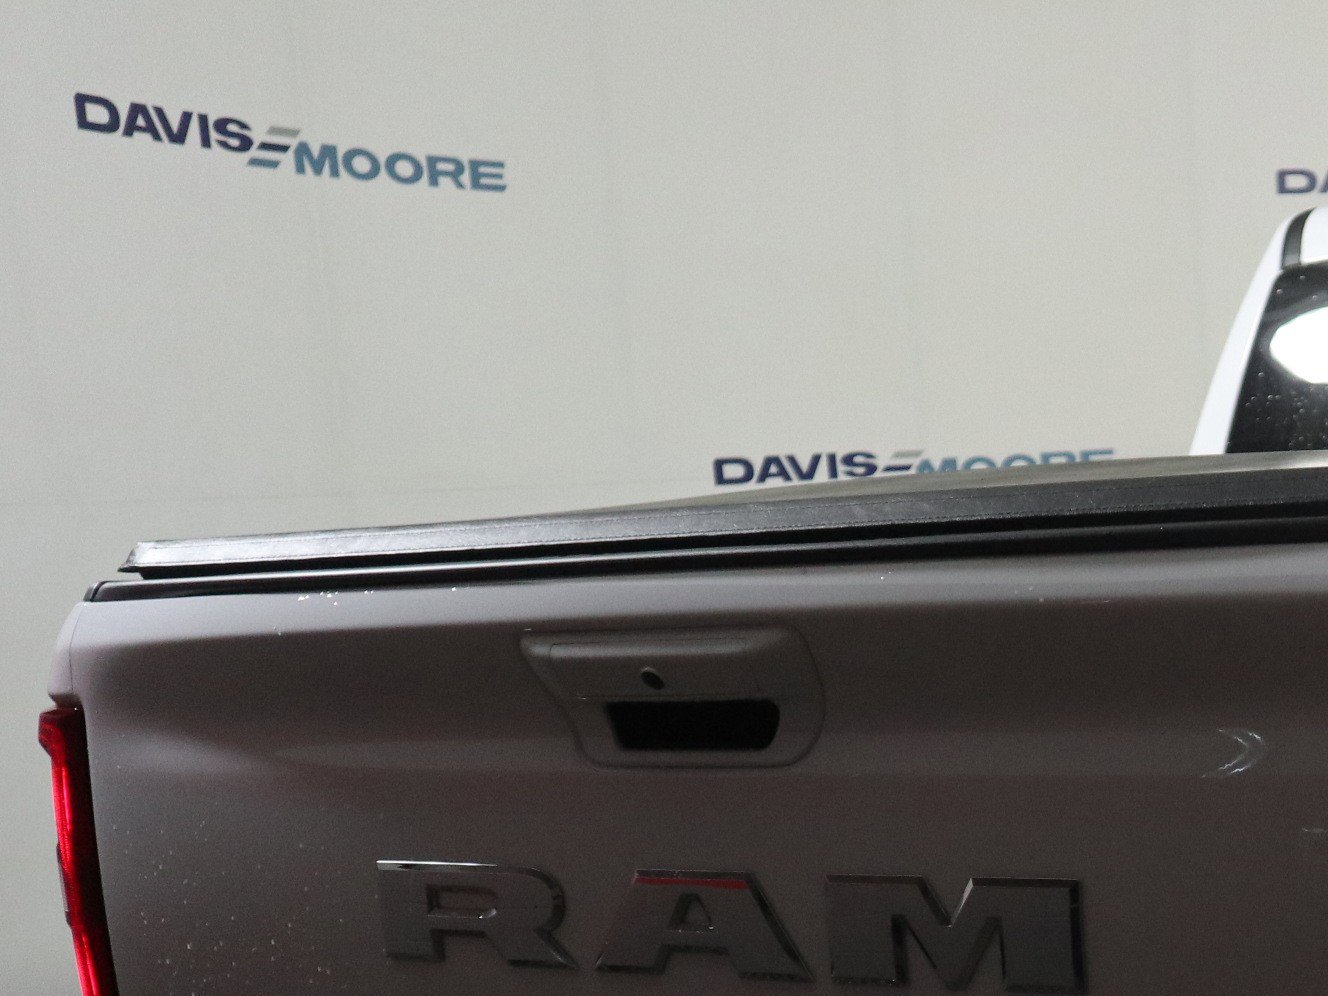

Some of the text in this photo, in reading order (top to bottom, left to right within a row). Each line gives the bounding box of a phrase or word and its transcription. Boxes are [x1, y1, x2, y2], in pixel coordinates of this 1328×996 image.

[73, 92, 508, 192] DAVIS MOORE
[712, 450, 879, 486] DAVIS
[376, 859, 1087, 995] RAM
